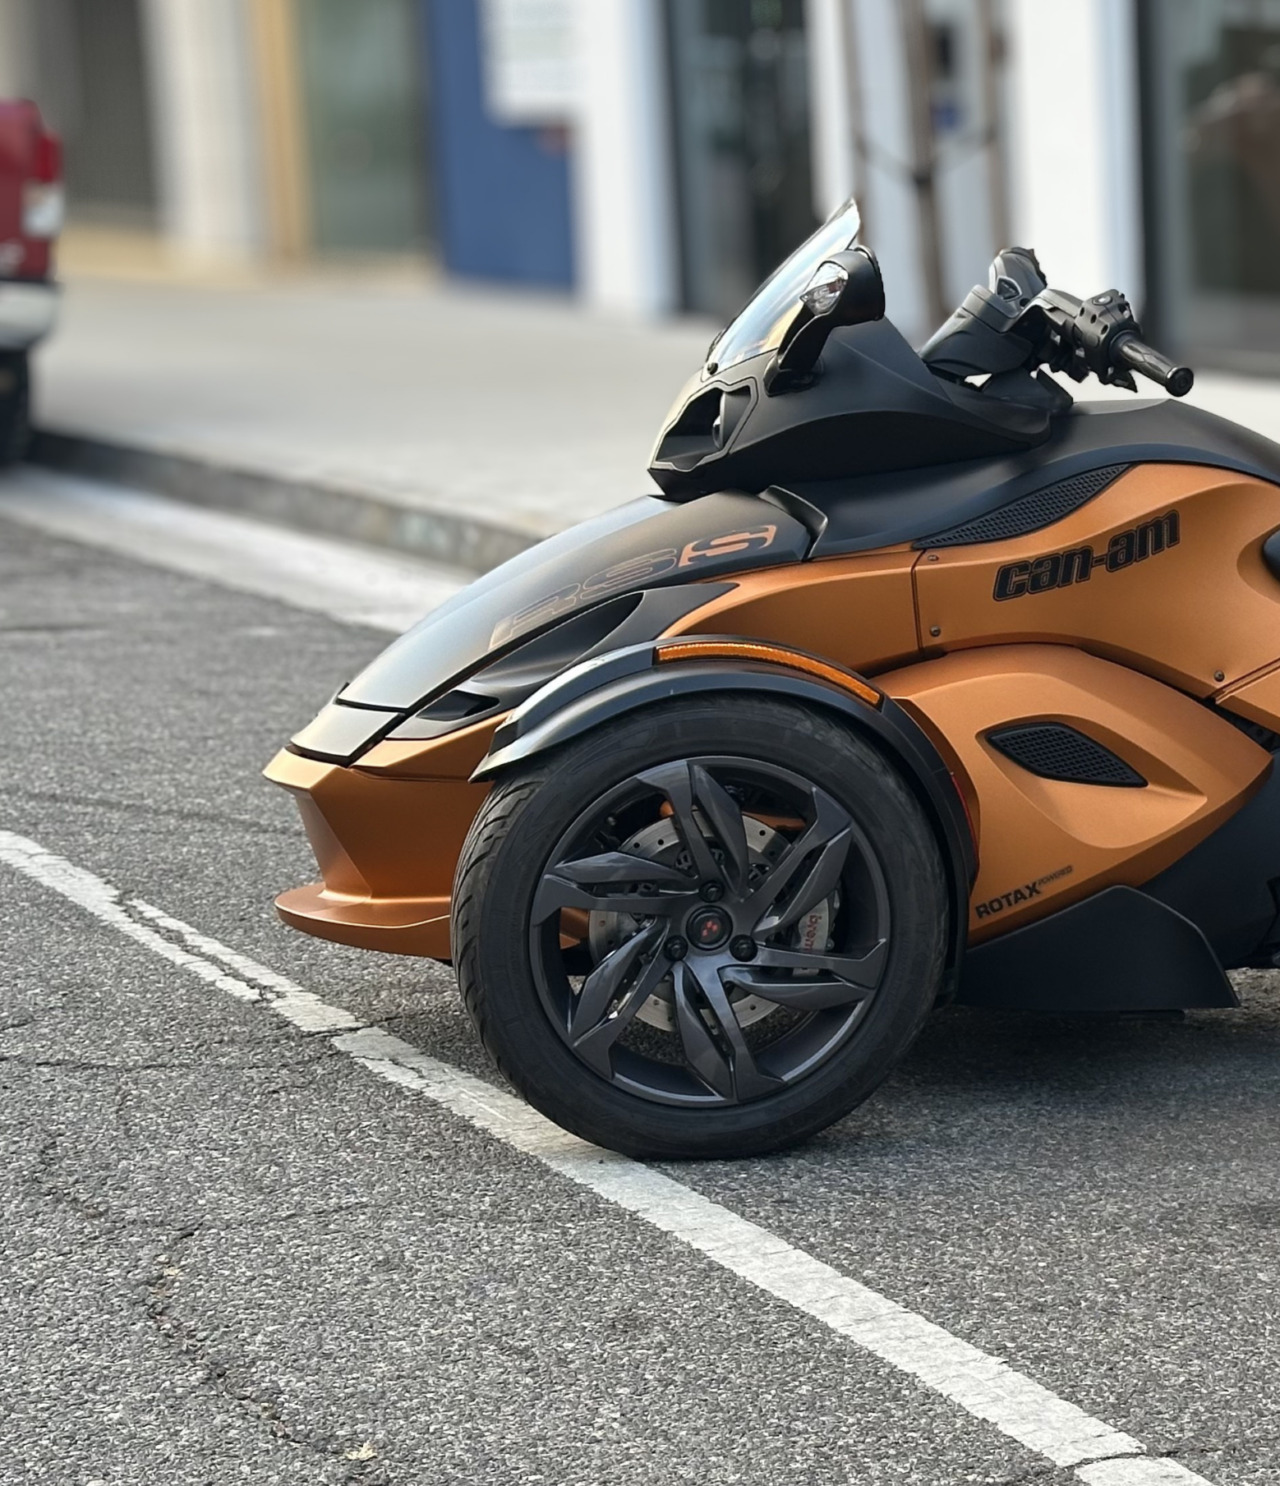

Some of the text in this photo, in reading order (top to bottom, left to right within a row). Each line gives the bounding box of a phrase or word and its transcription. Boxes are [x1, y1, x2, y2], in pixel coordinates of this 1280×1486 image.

[993, 509, 1181, 602] can-am
[975, 881, 1042, 919] ROTAX
[803, 914, 822, 952] brem
